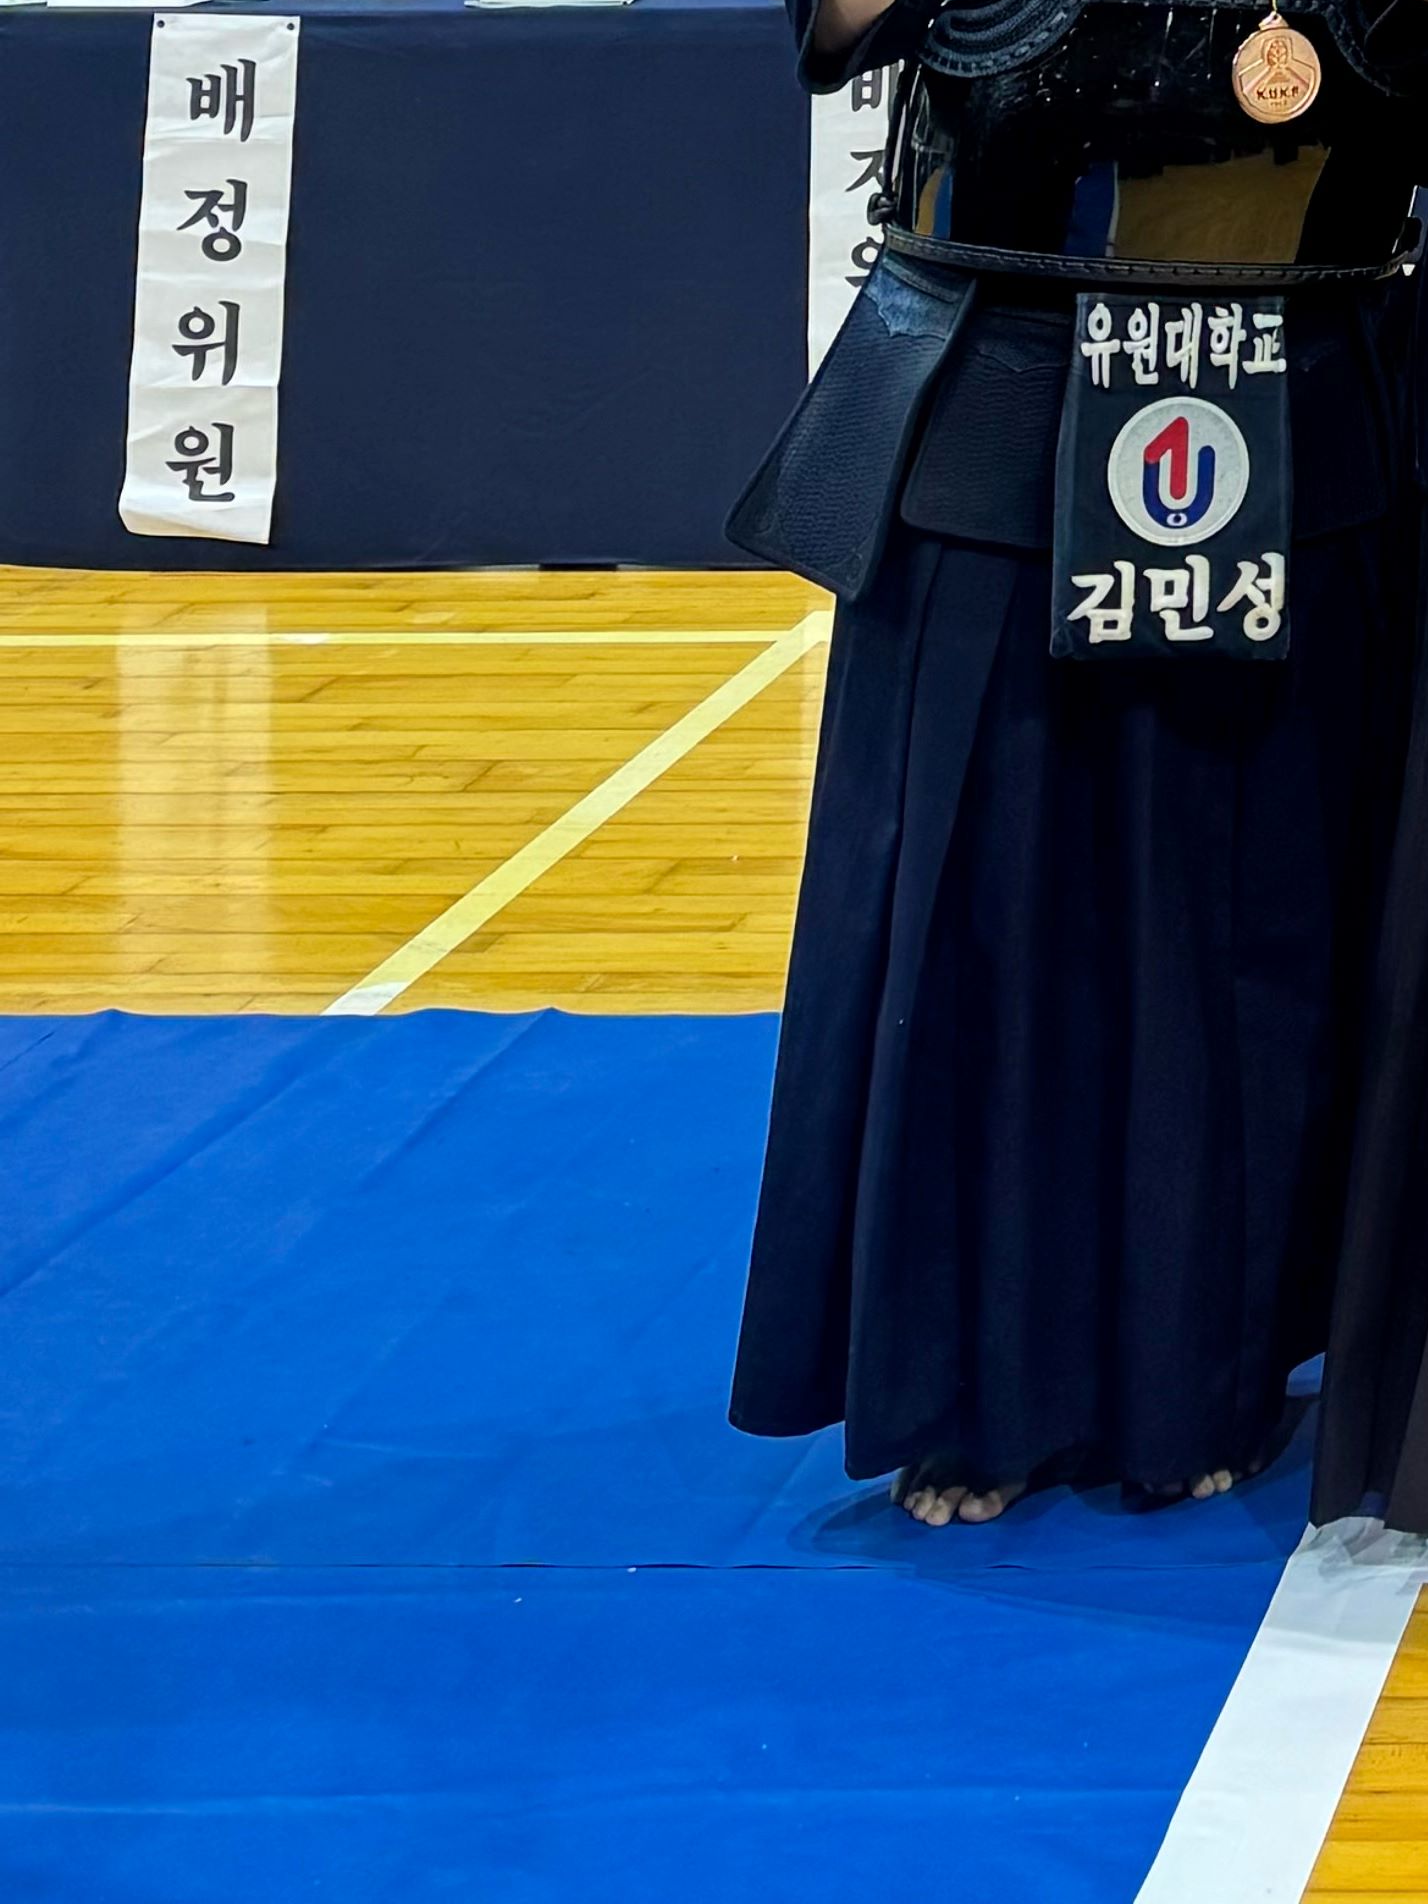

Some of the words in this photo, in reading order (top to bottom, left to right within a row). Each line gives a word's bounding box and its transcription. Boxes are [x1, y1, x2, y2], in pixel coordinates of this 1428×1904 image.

[165, 58, 257, 503] 배정위원
[1080, 302, 1287, 390] 유원대학교
[1066, 552, 1285, 644] 김민성
